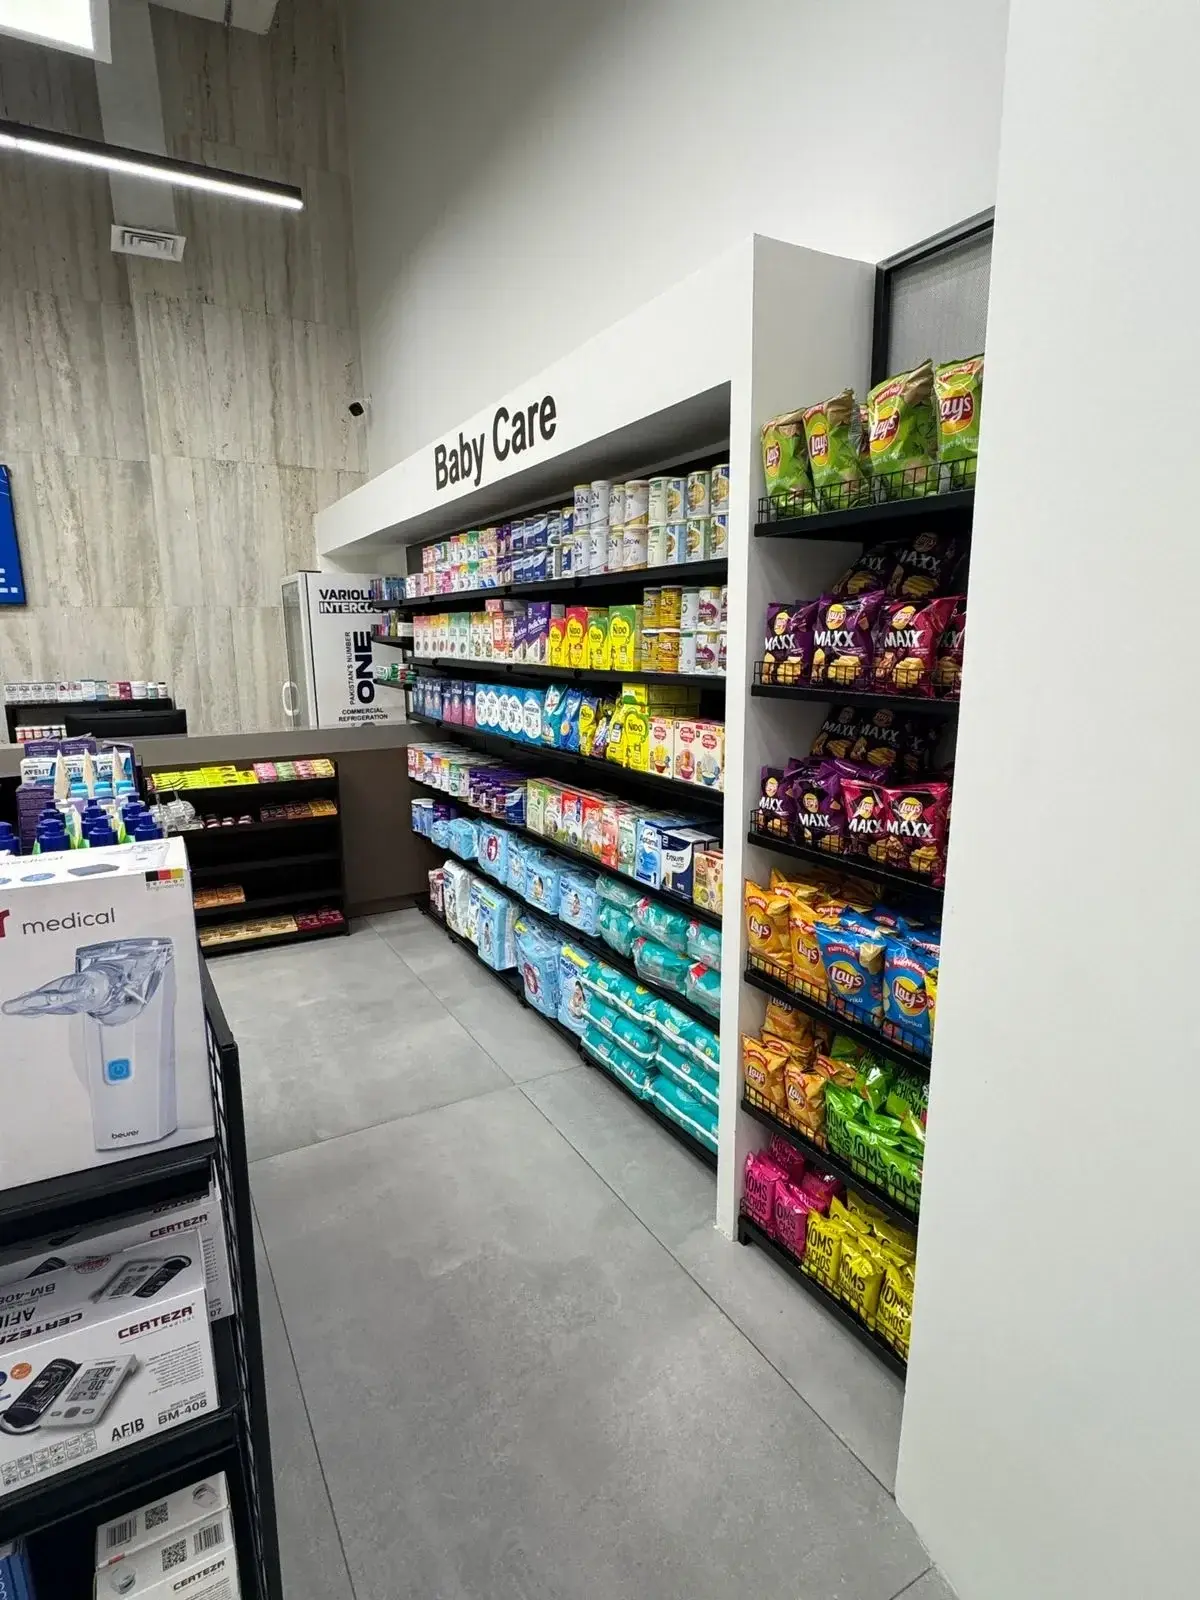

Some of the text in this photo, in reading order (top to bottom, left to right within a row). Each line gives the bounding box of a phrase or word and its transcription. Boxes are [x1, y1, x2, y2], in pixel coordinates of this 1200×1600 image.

[434, 395, 557, 491] Baby Care
[576, 496, 588, 504] AN
[319, 589, 372, 600] VARIOL
[814, 630, 855, 648] MAXX
[353, 631, 375, 704] ONE
[338, 713, 388, 723] REFRIGERATION
[341, 707, 384, 715] COMMERCIAL
[887, 819, 933, 838] MAXX
[665, 852, 685, 863] Ensure
[22, 907, 116, 936] medical
[111, 1130, 139, 1139] beurer
[150, 1213, 208, 1238] CERTEZA
[118, 1305, 193, 1339] CERTEZA
[158, 1399, 208, 1425] BM-408
[111, 1418, 145, 1442] AFIB
[173, 1559, 225, 1591] CERTEZA
